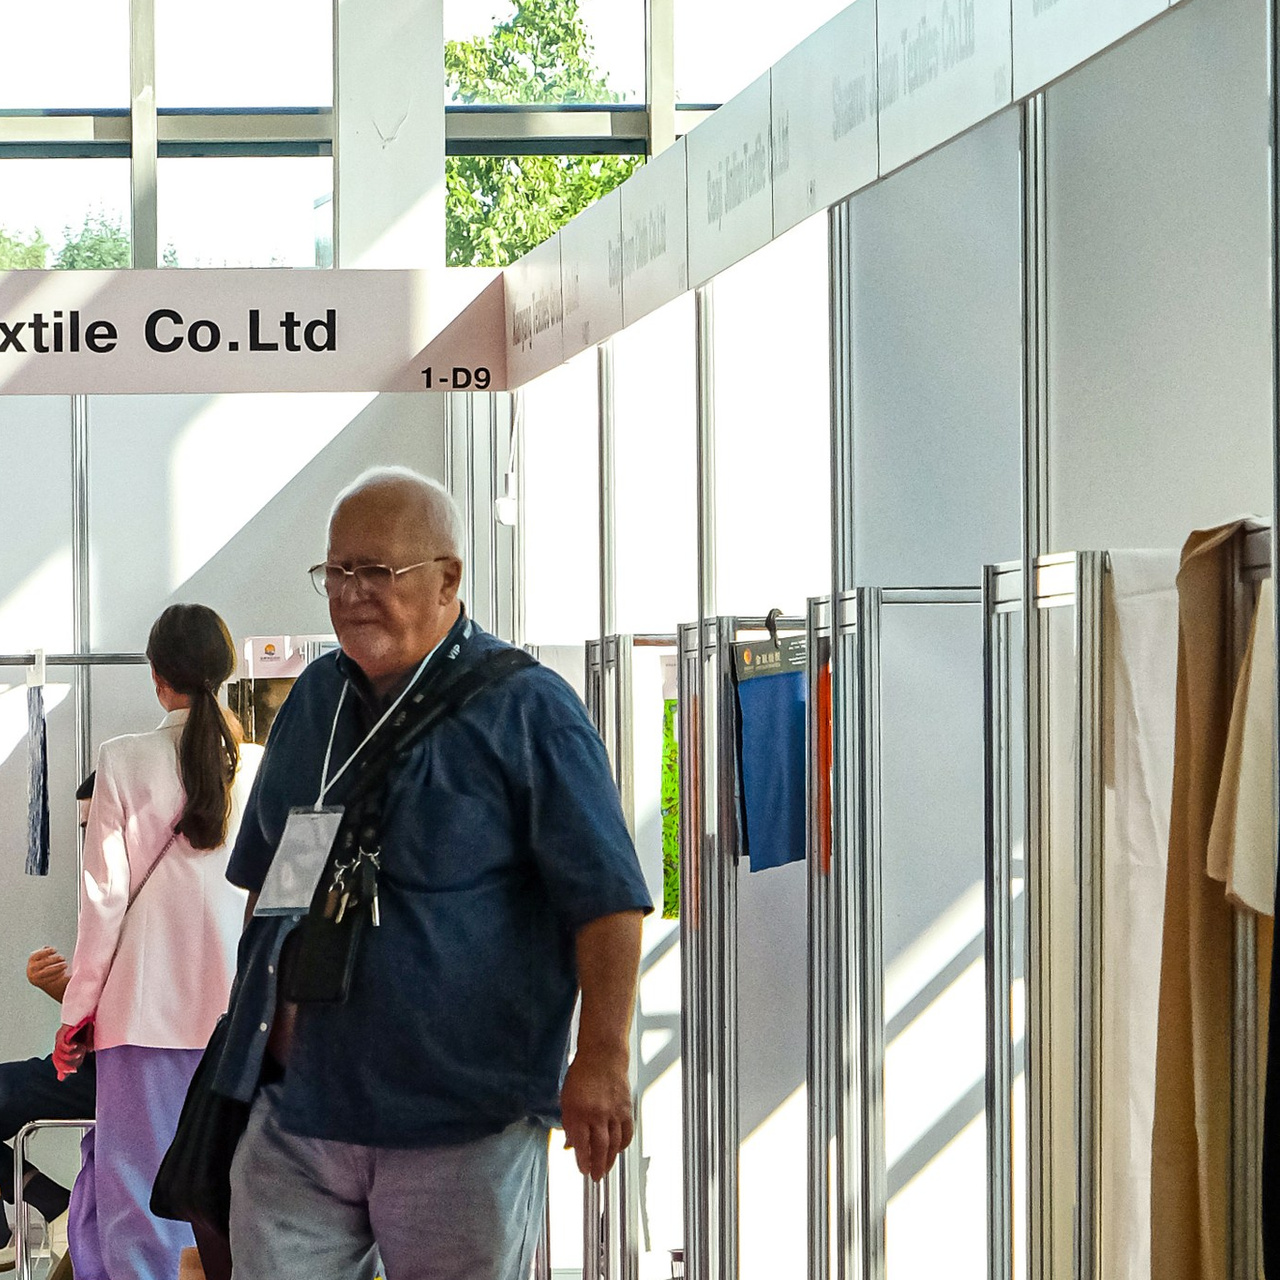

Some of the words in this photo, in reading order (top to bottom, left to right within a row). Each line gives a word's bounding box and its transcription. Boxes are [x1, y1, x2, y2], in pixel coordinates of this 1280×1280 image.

[144, 308, 336, 353] Co.Ltd
[421, 366, 491, 390] 1-D9
[447, 643, 460, 660] VIP
